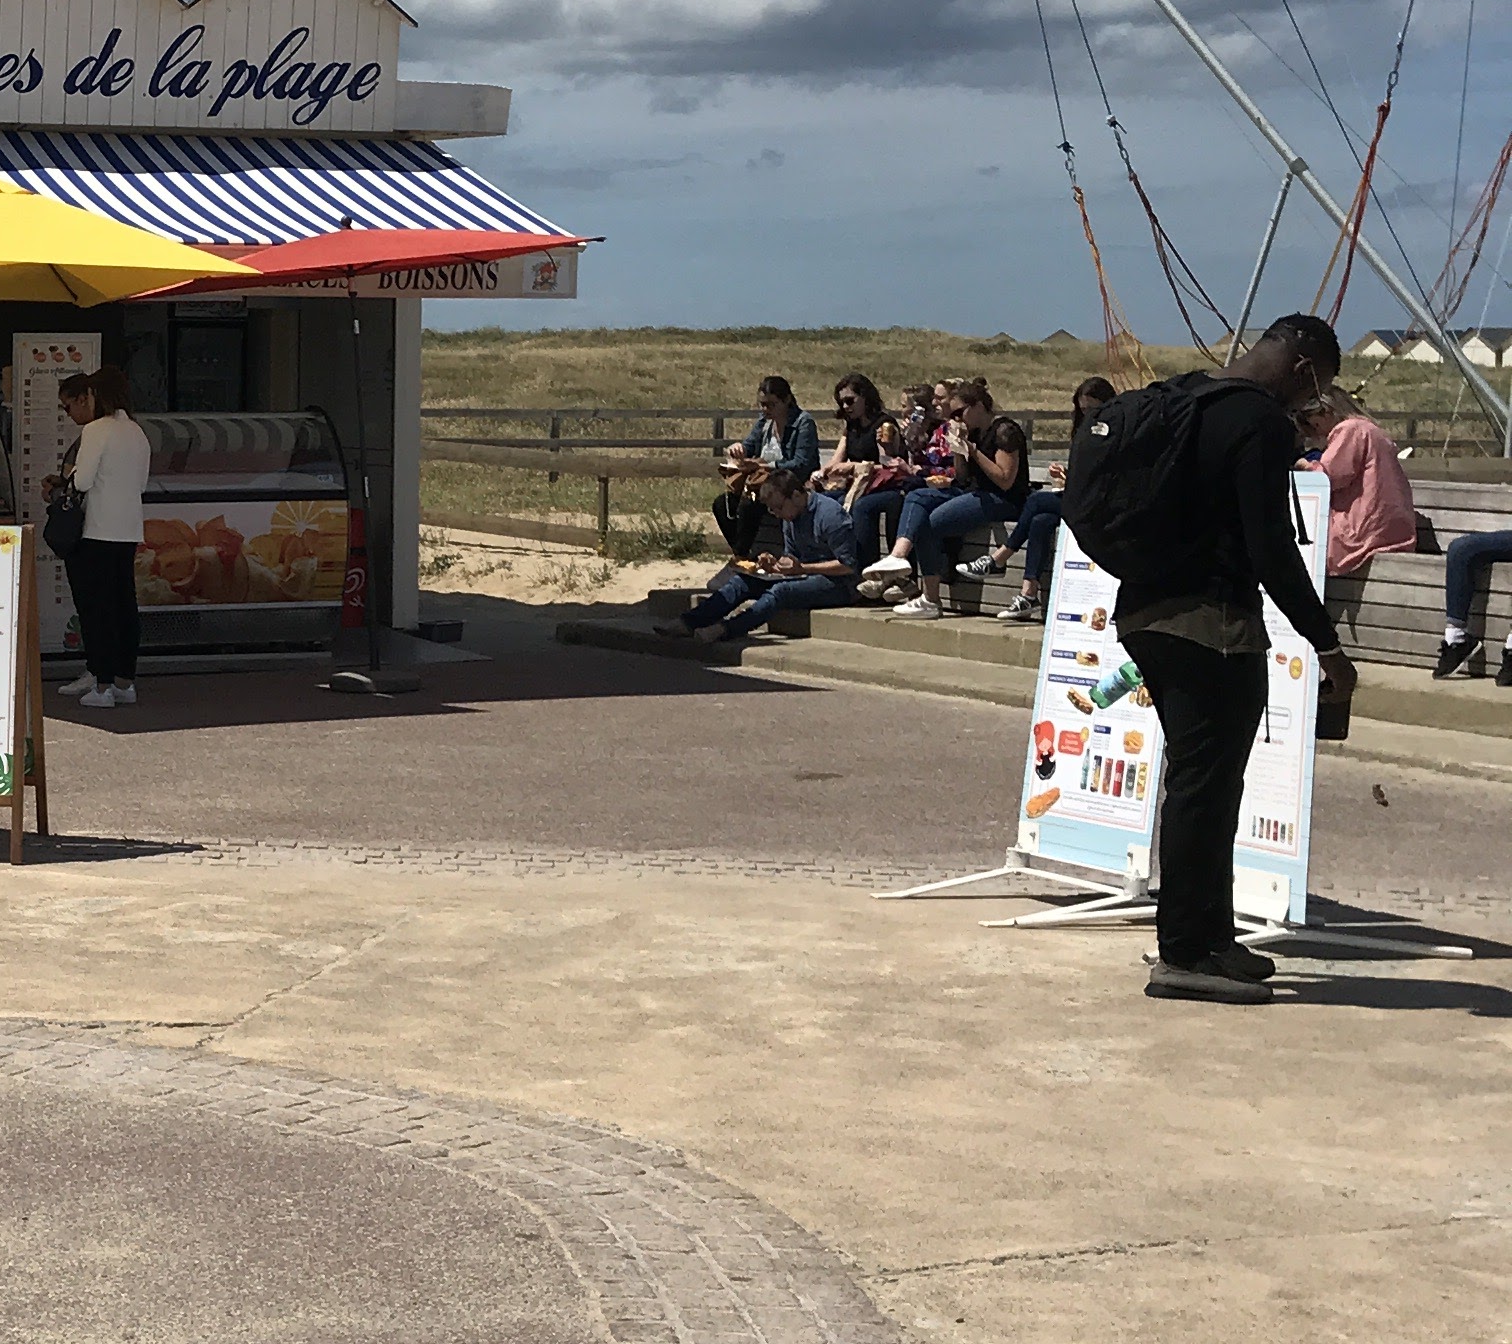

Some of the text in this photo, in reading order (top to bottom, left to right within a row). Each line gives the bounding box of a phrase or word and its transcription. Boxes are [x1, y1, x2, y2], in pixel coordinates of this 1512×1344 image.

[63, 28, 135, 96] de
[149, 25, 212, 99] la
[207, 27, 381, 126] plage
[377, 262, 499, 290] BOISSONS
